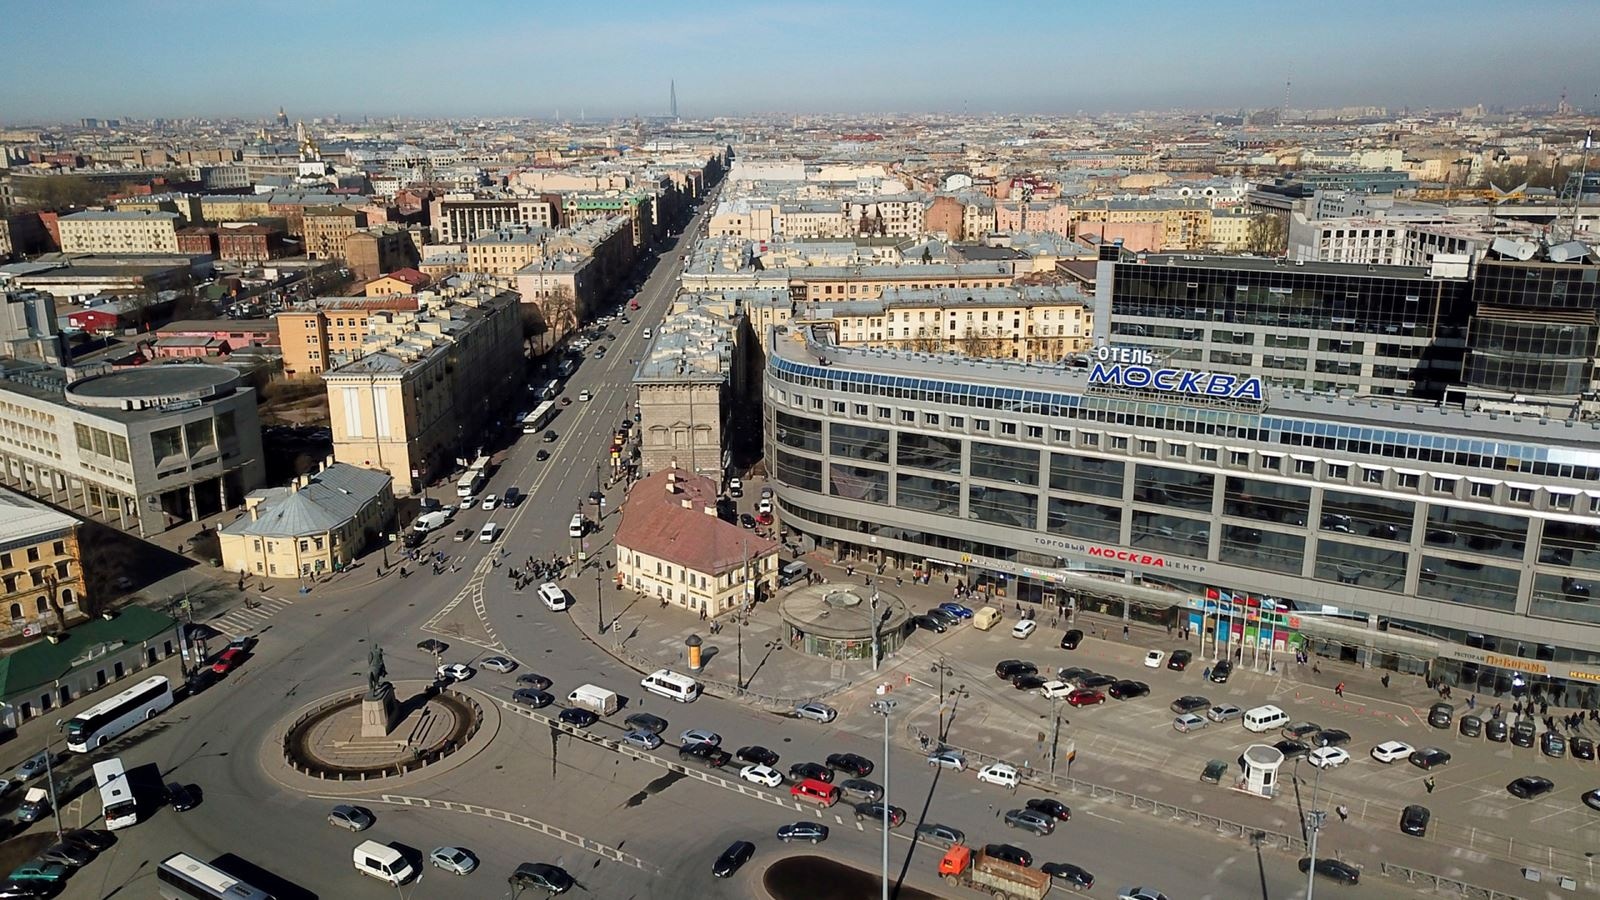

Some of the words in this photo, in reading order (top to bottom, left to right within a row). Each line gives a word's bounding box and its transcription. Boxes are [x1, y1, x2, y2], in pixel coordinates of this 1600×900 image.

[1097, 346, 1153, 364] ОТЕЛЬ
[1088, 363, 1263, 401] МОСКВА
[1034, 537, 1085, 552] ТОРГОВЫЙ
[1088, 546, 1165, 568] МОСКВА
[1165, 559, 1206, 573] ЦЕНТР
